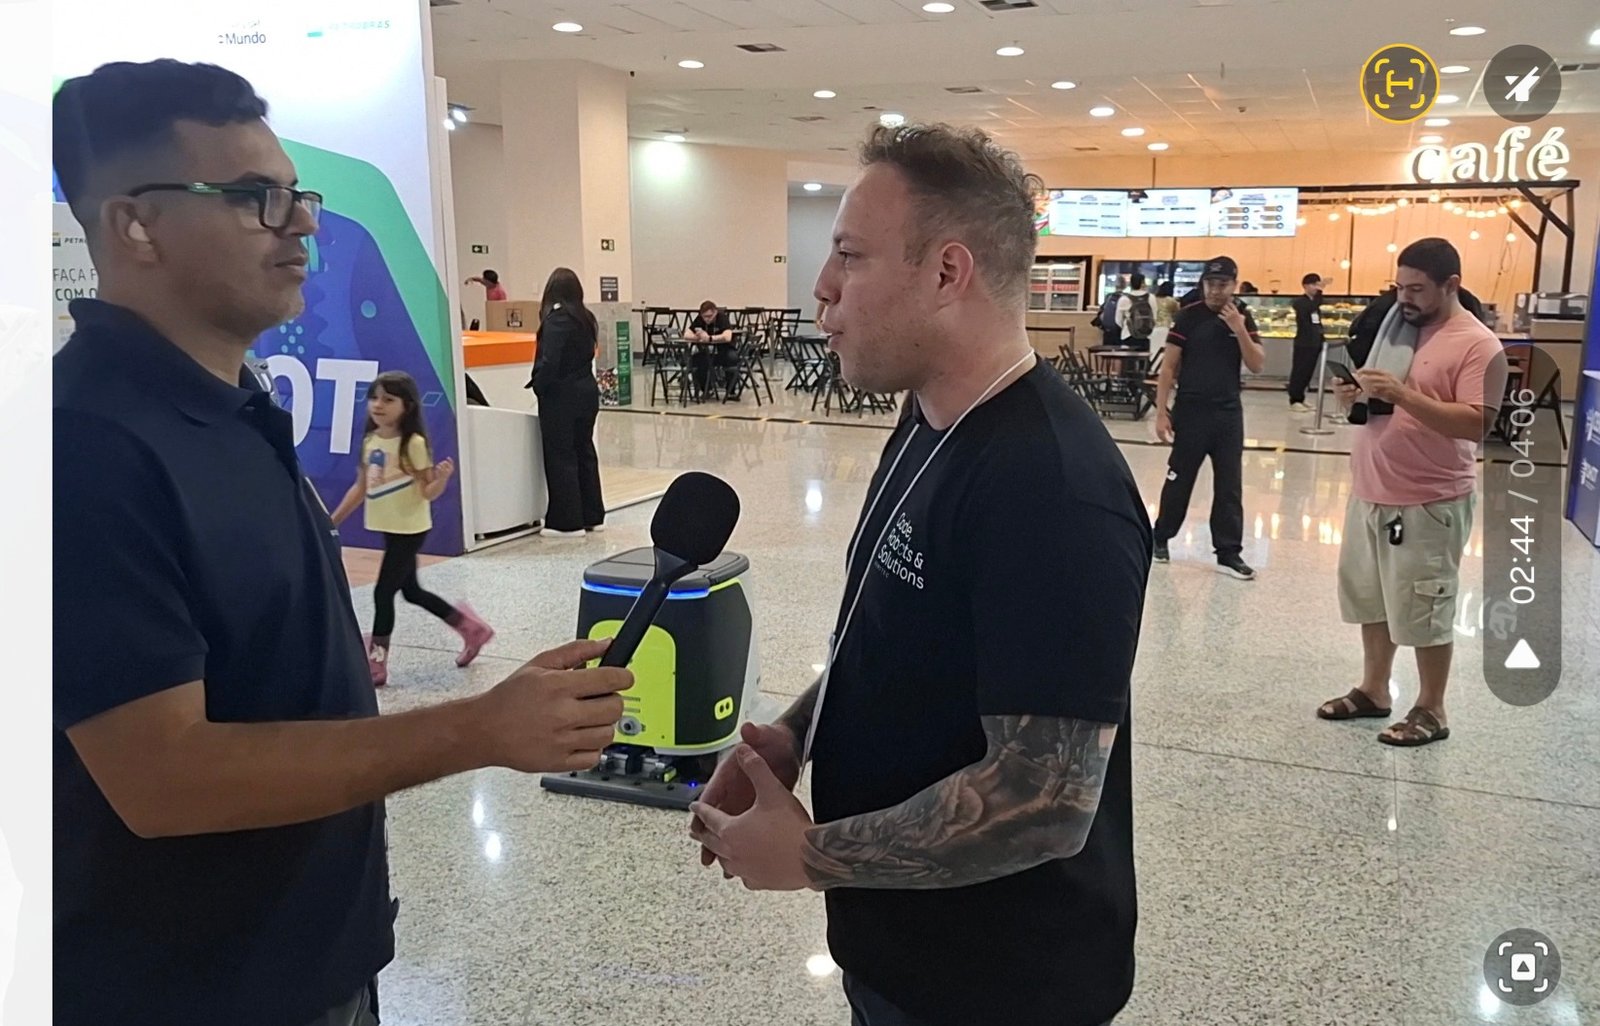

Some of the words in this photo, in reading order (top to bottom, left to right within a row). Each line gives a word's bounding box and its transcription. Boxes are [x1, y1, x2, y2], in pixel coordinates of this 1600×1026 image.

[1411, 125, 1569, 182] café
[52, 268, 87, 283] FAÇA
[55, 288, 84, 301] COM
[878, 544, 924, 589] Solutions
[913, 552, 924, 570] &
